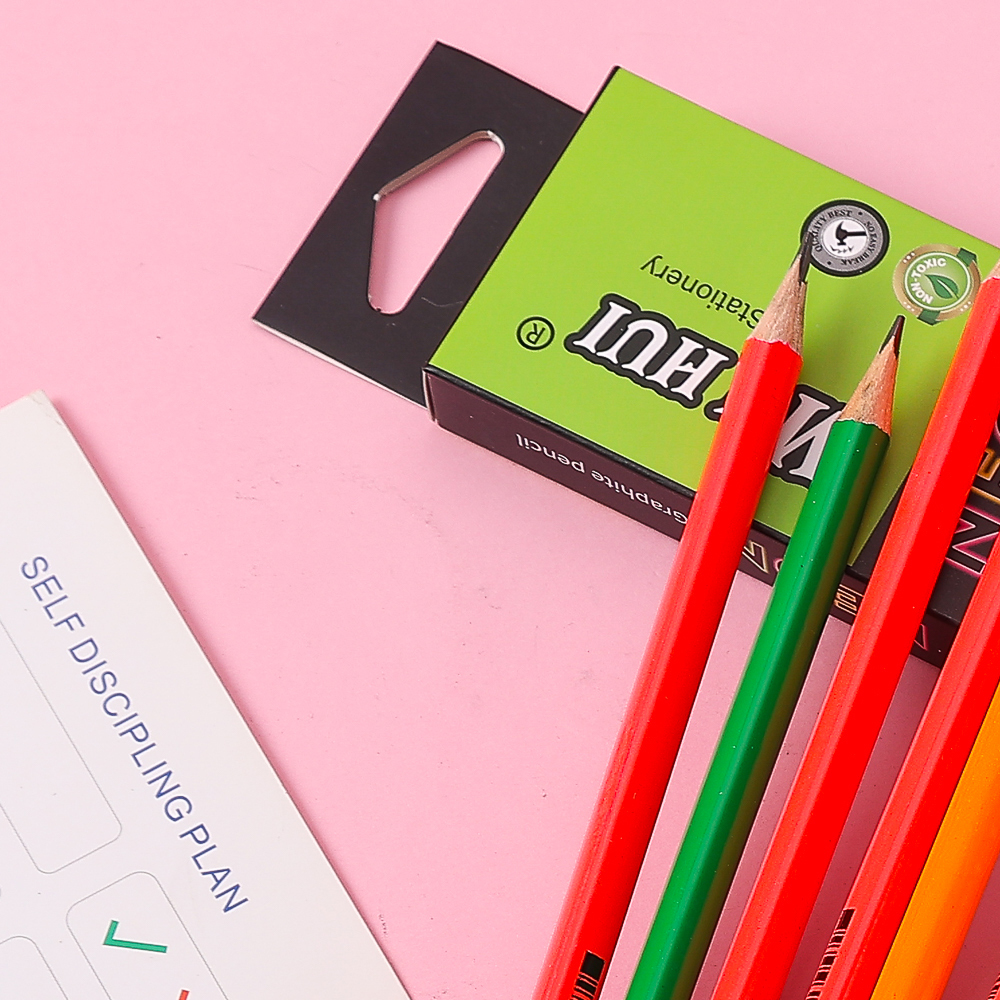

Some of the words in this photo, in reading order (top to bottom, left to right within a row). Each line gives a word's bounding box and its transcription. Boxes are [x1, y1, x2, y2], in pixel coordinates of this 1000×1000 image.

[828, 208, 852, 219] BEST
[639, 254, 765, 331] Stationery
[910, 257, 947, 305] NON-TOXIC
[516, 433, 585, 474] pencil
[591, 470, 689, 525] Graphite
[20, 556, 85, 632] SELF
[68, 637, 193, 822] DISCIPLING
[179, 823, 249, 914] PLAN
